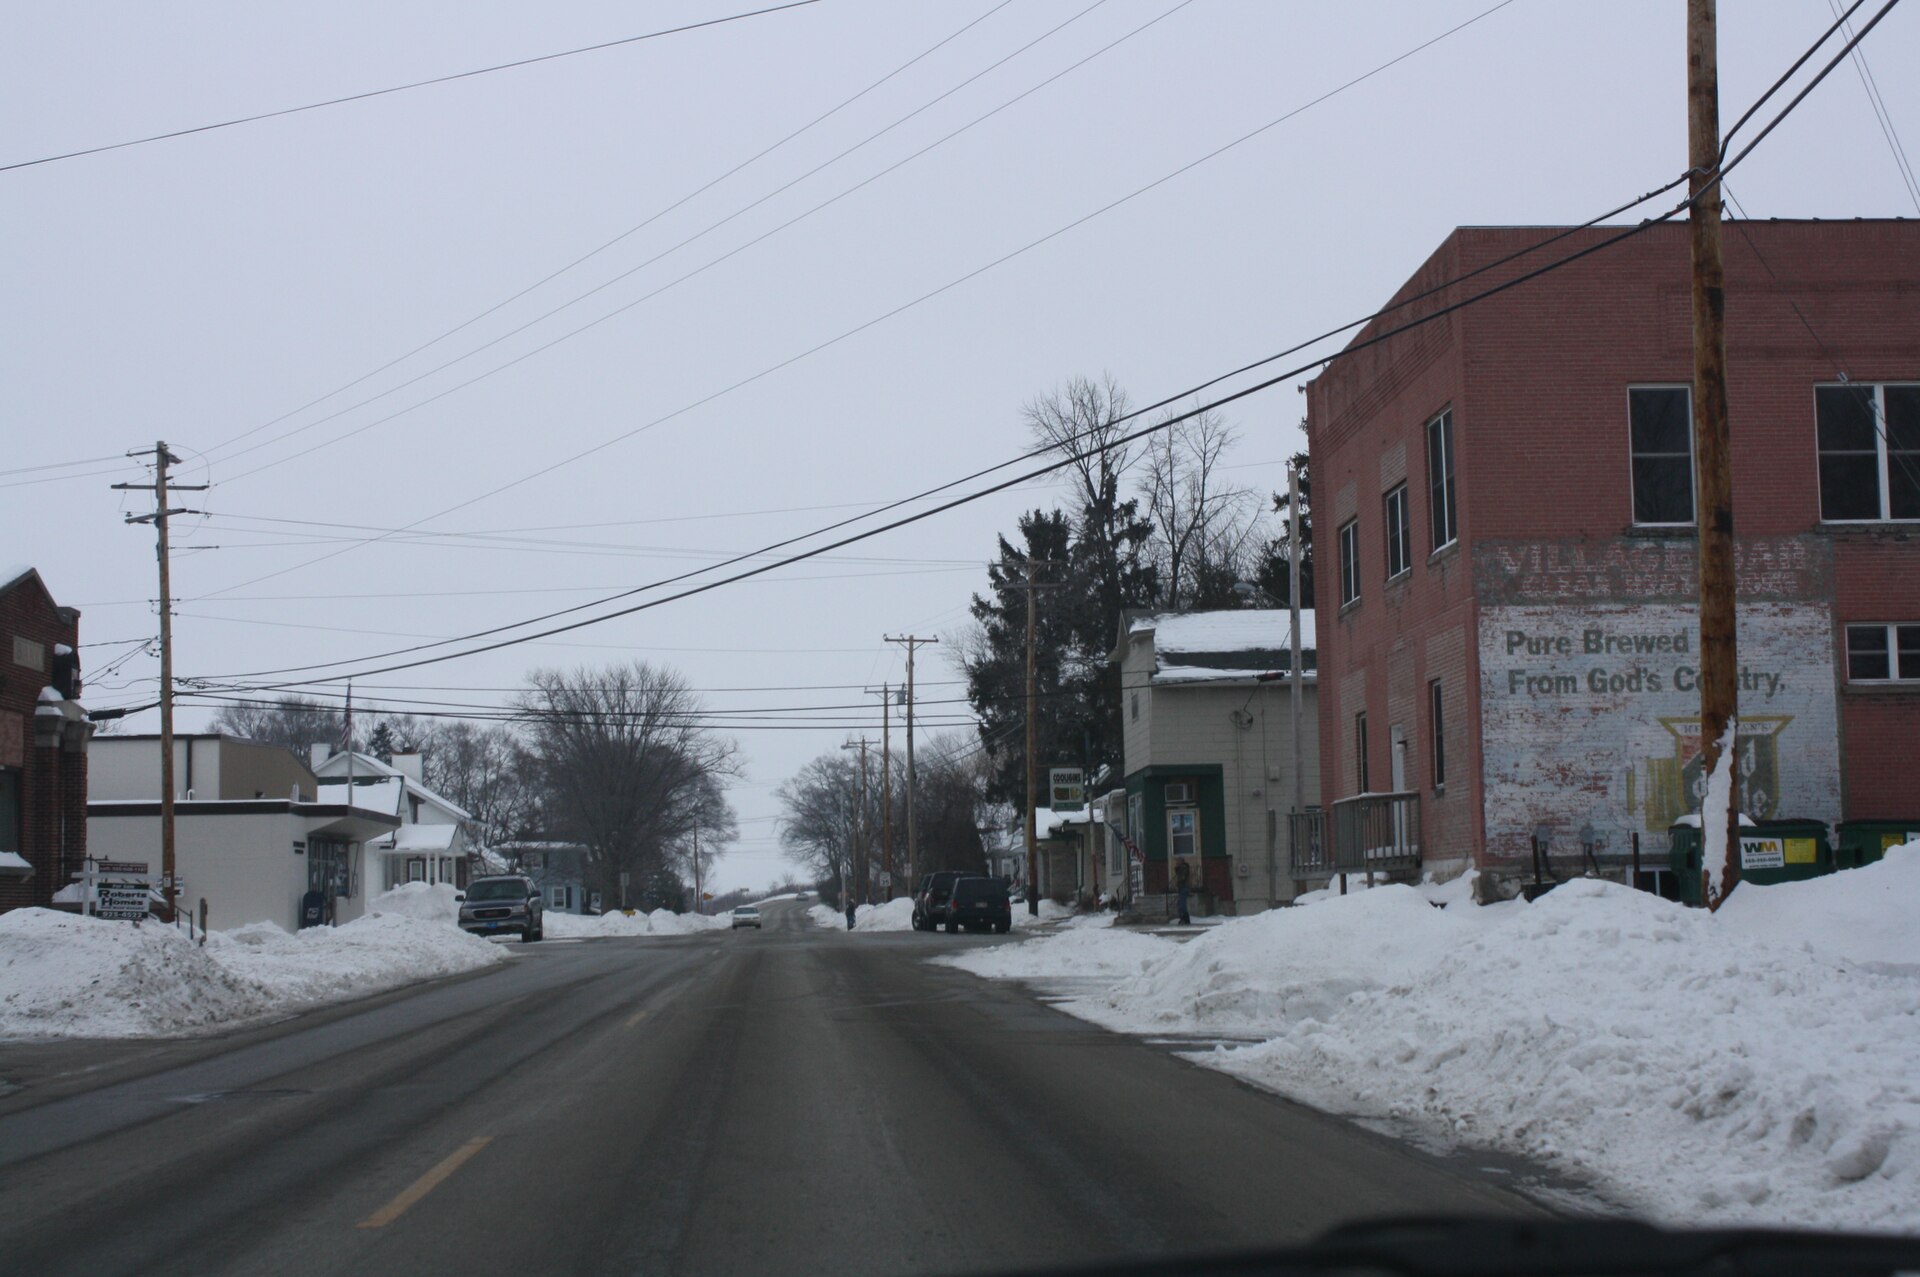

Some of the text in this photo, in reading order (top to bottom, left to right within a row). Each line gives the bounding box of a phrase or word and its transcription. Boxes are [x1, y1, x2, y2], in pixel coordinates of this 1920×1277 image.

[1506, 628, 1689, 655] Pure Brewed
[1508, 668, 1578, 695] From
[1587, 667, 1662, 693] God's
[98, 889, 147, 898] Roberts
[102, 897, 143, 906] Homes
